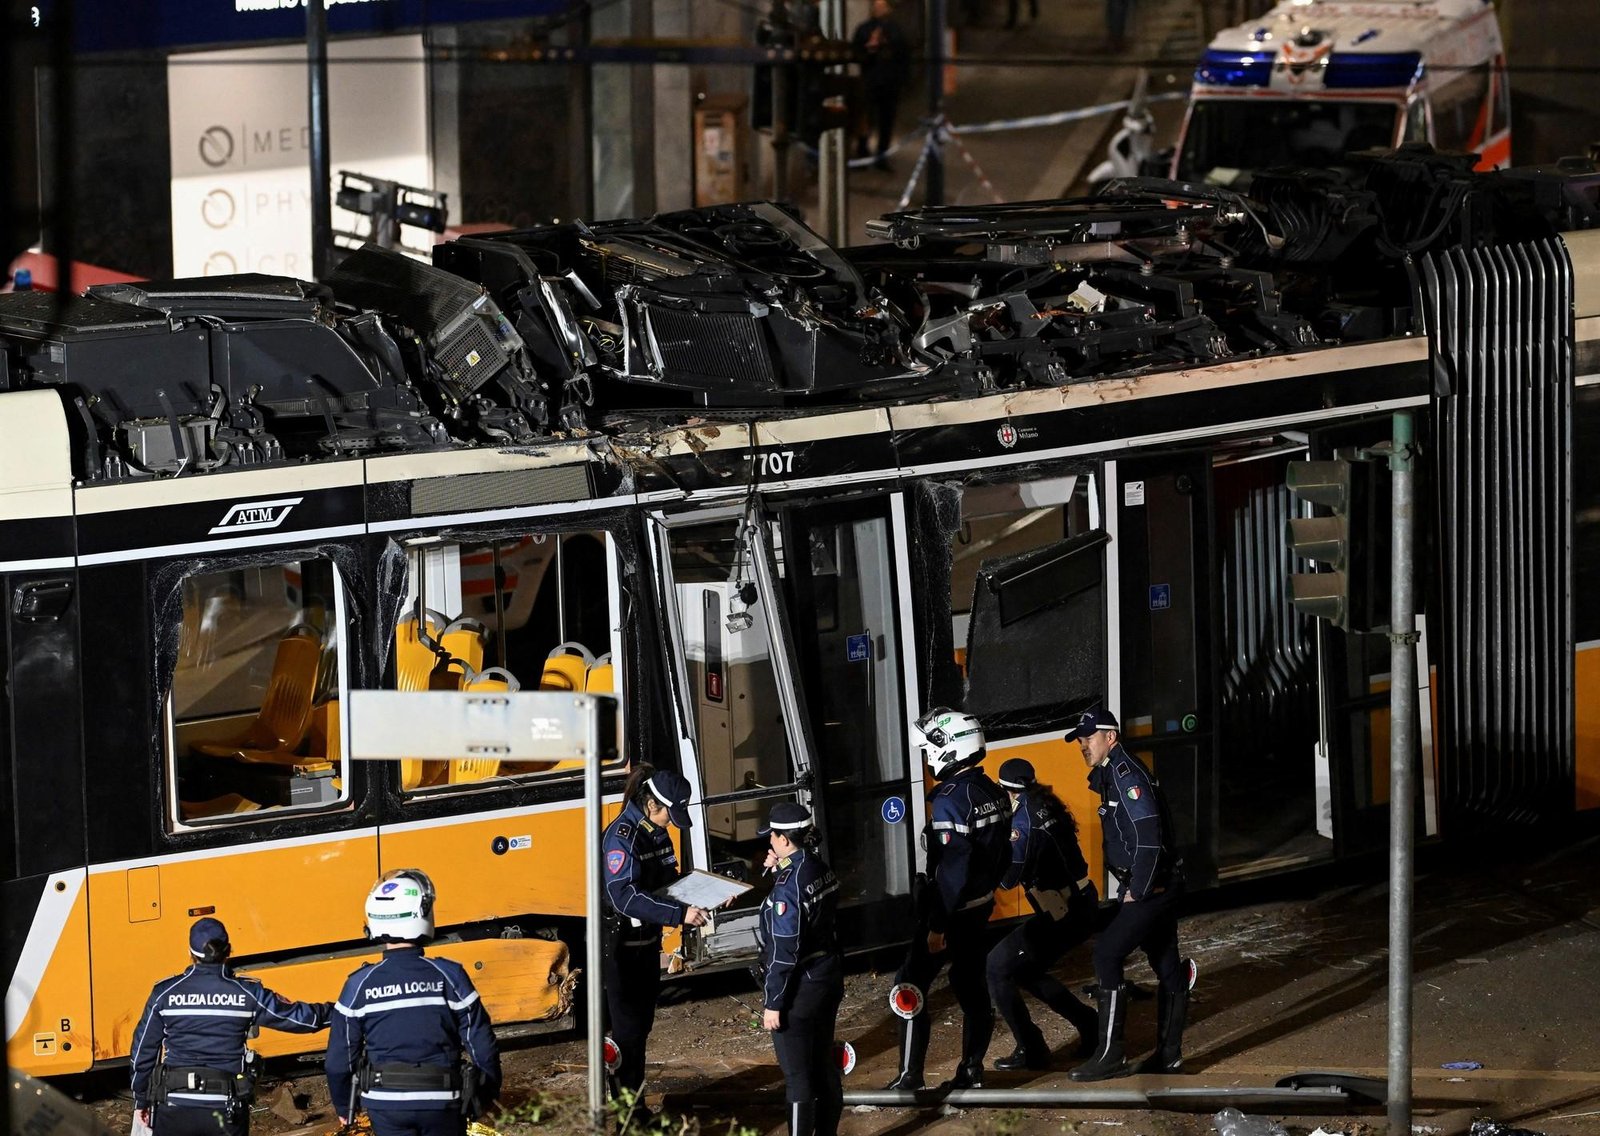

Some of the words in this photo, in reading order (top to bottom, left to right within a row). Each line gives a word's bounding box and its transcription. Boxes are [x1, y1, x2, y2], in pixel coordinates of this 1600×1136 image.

[236, 507, 274, 525] ATM
[938, 716, 952, 728] 39
[404, 888, 419, 897] 38
[365, 984, 403, 1000] POLIZIA
[404, 981, 444, 995] LOCALE
[168, 993, 206, 1007] POLIZIA
[207, 993, 246, 1007] LOCALE
[61, 1018, 71, 1032] B
